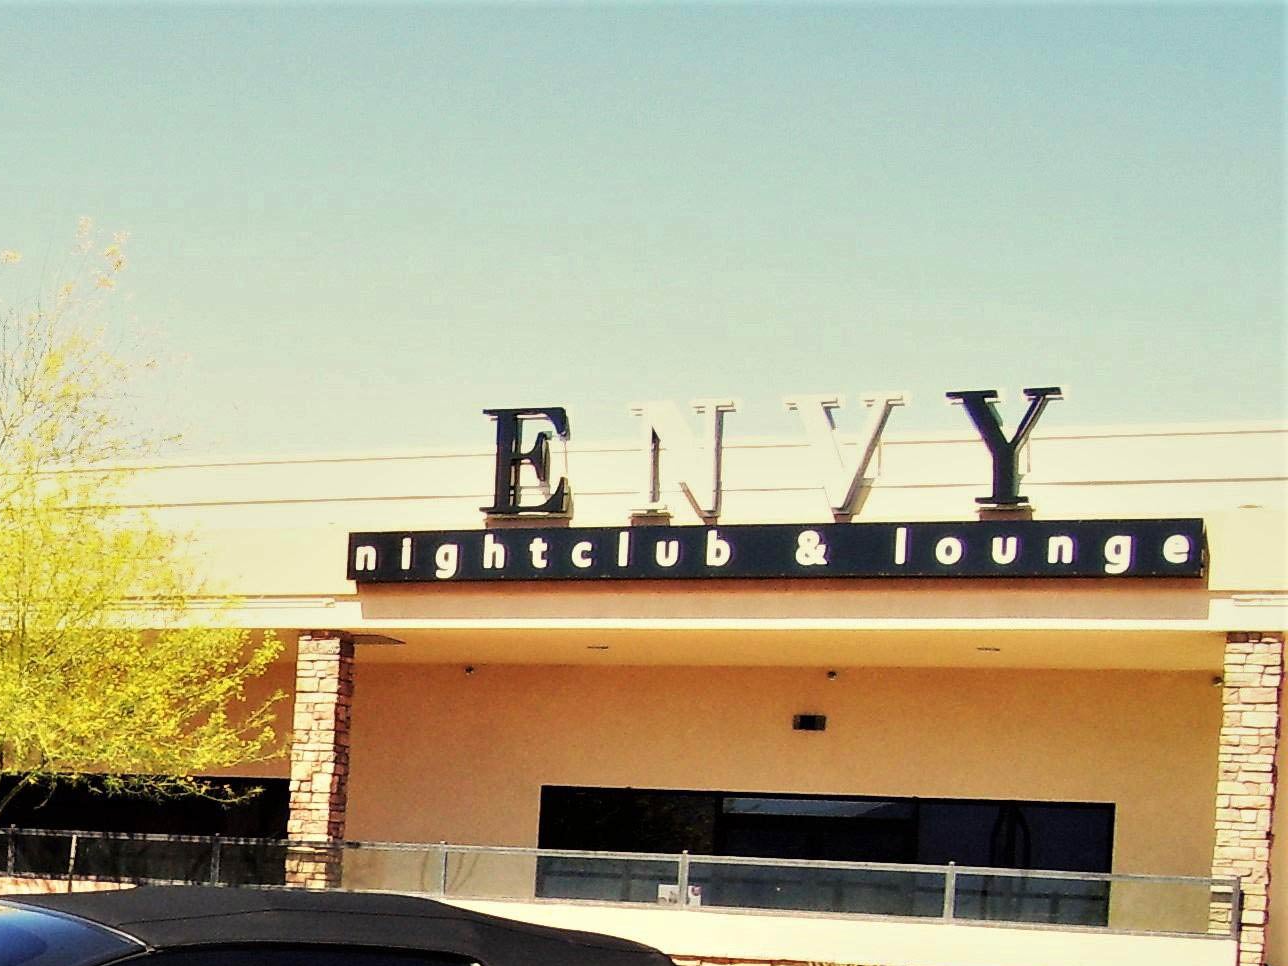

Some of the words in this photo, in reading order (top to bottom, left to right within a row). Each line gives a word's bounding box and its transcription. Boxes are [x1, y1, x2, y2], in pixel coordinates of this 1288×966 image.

[479, 386, 1065, 517] ENVY
[354, 530, 731, 579] nightclub
[795, 530, 829, 566] &
[894, 527, 1192, 574] lounge
